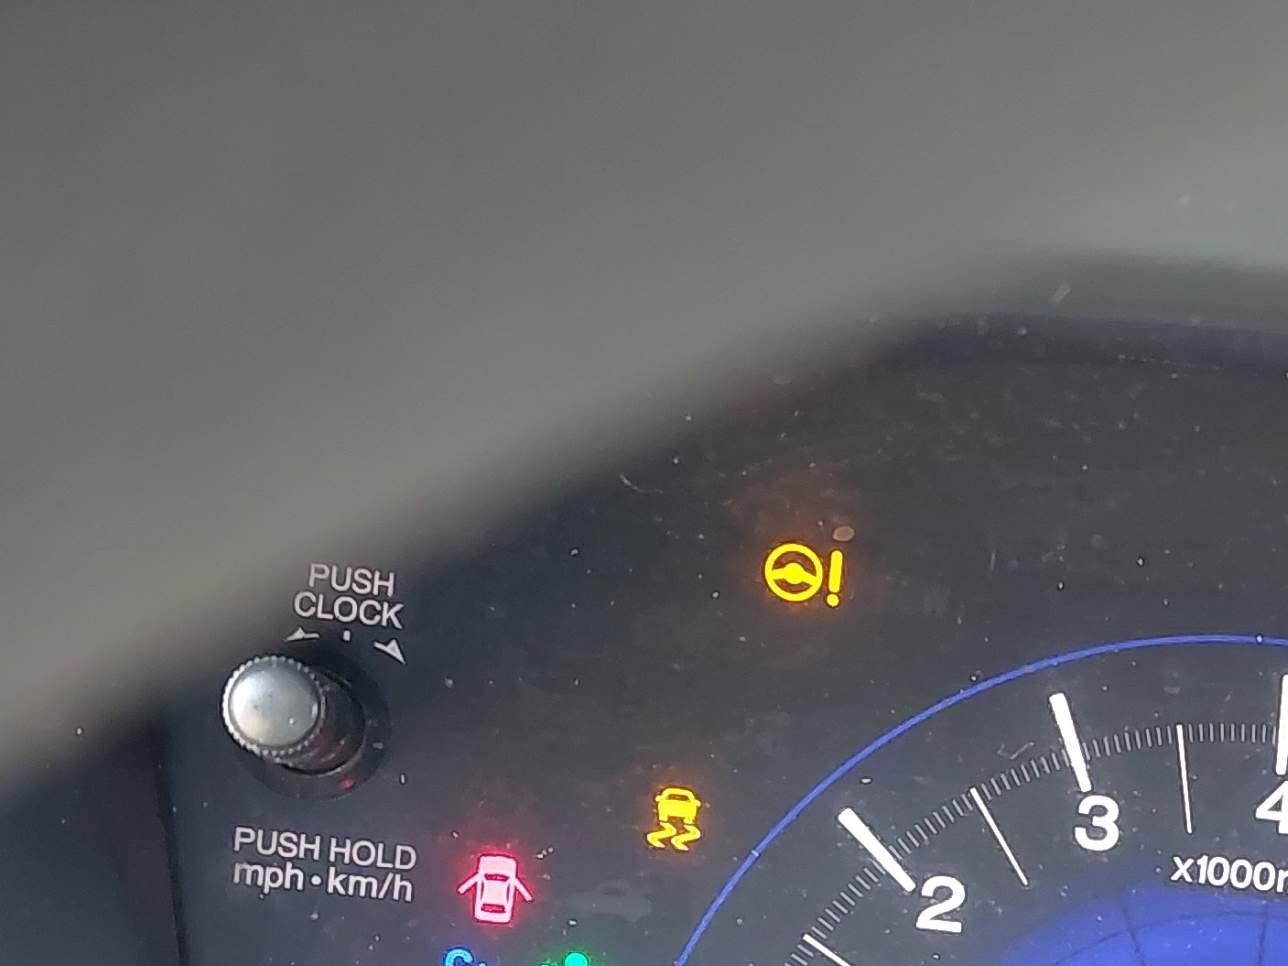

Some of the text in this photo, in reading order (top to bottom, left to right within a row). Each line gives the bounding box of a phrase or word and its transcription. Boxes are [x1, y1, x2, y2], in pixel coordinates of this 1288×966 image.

[308, 563, 395, 597] PUSH
[294, 591, 404, 629] CLOCK
[1074, 794, 1120, 852] 3
[233, 826, 416, 871] PUSH HOLD
[915, 875, 967, 934] 2
